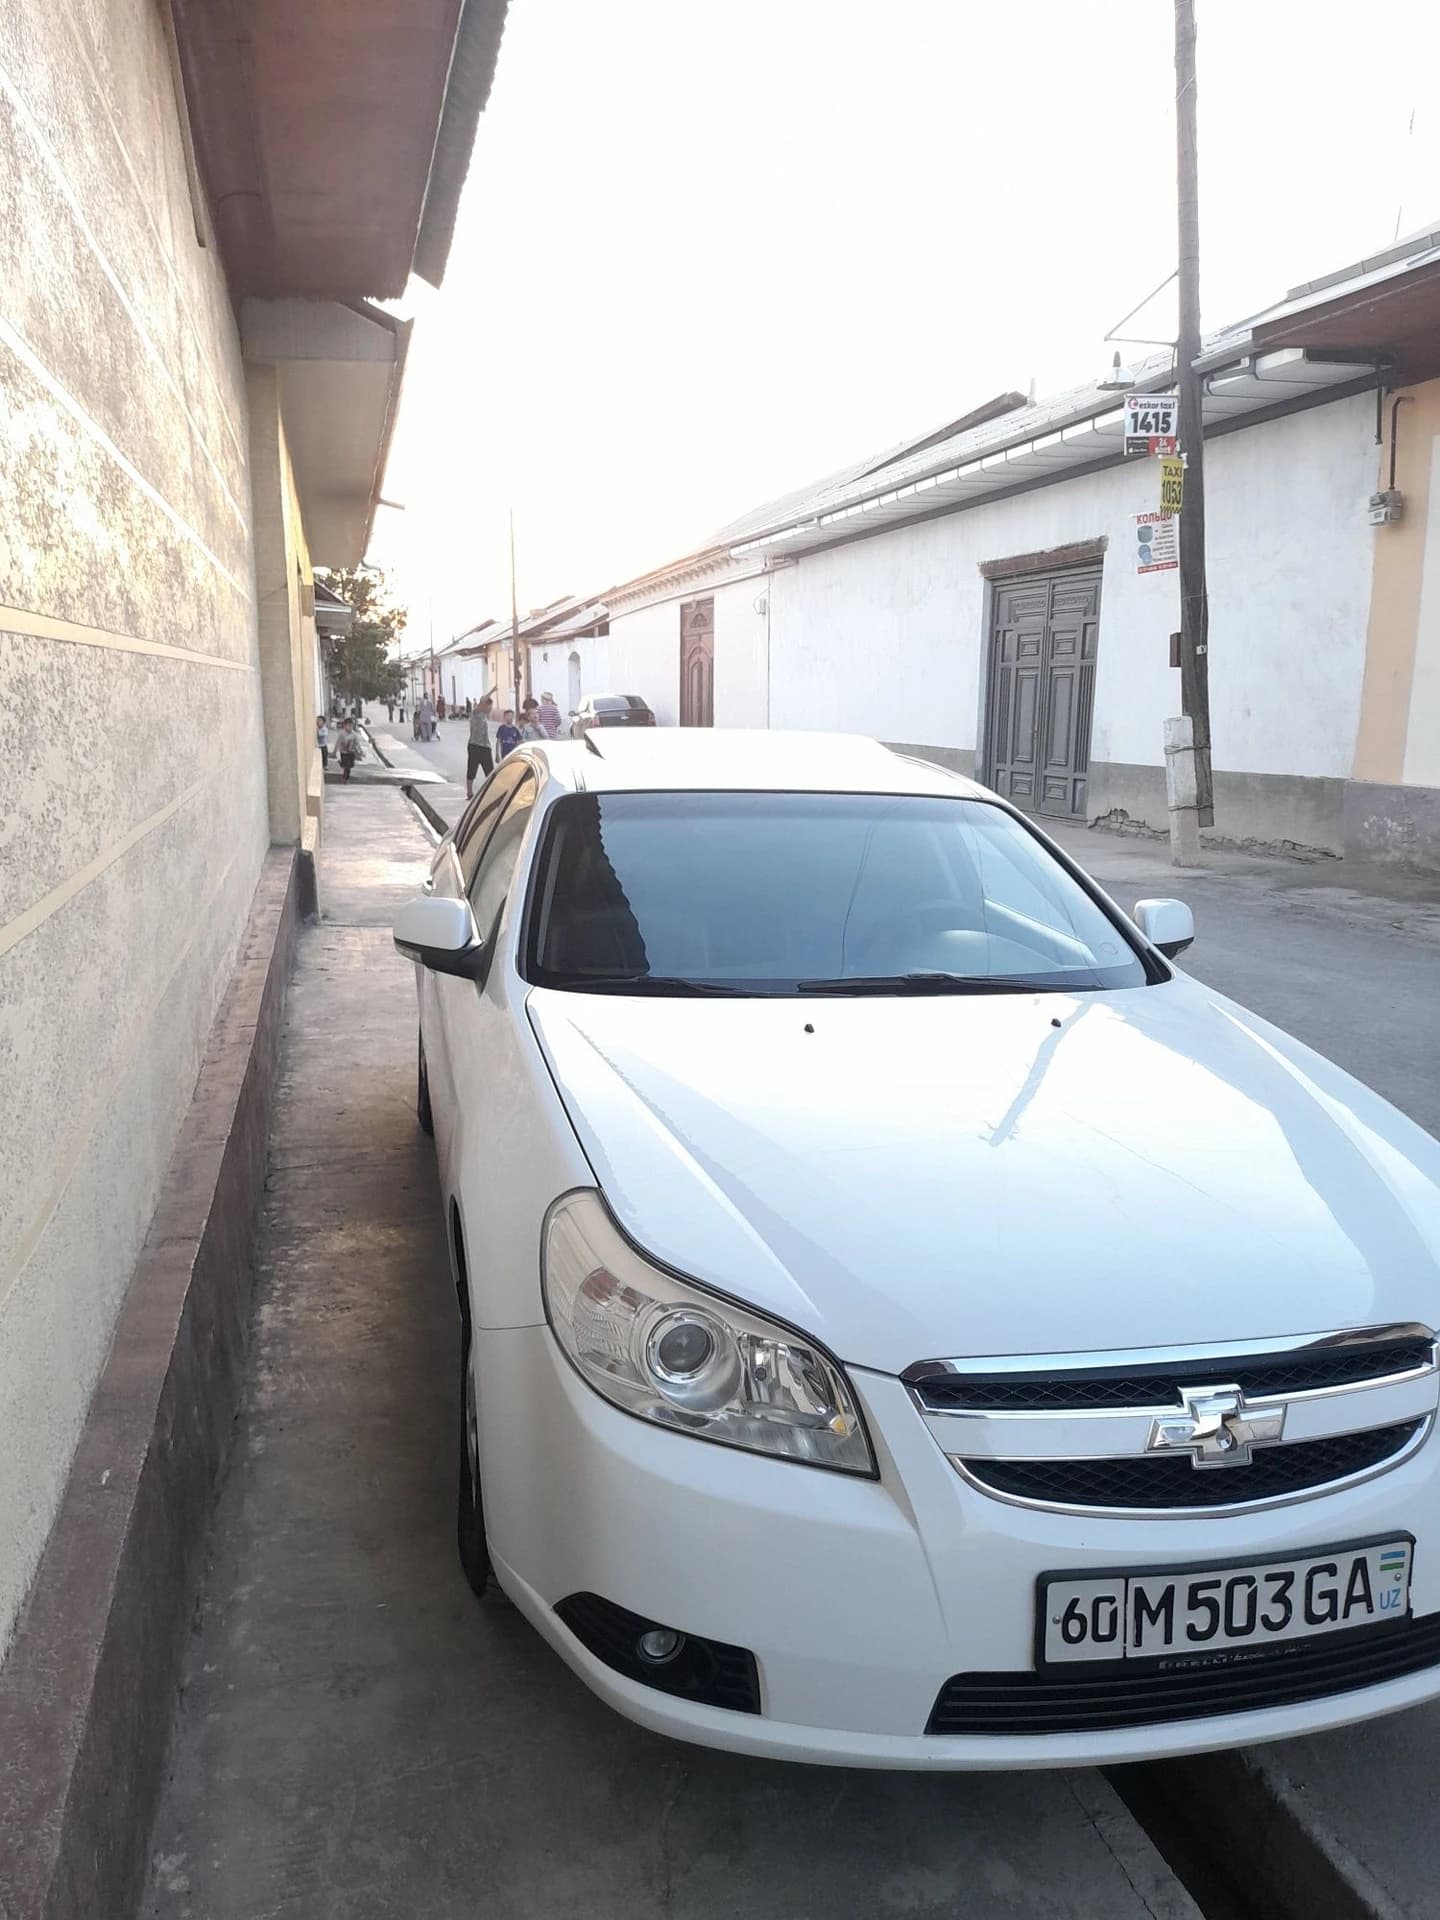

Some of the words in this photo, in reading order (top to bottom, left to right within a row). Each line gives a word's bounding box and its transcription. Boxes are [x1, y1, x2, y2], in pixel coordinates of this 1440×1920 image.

[1131, 411, 1171, 433] 1415
[1163, 465, 1182, 477] TAXI
[1162, 480, 1182, 505] 1053
[1061, 1595, 1118, 1645] 60
[1379, 1589, 1402, 1611] UZ
